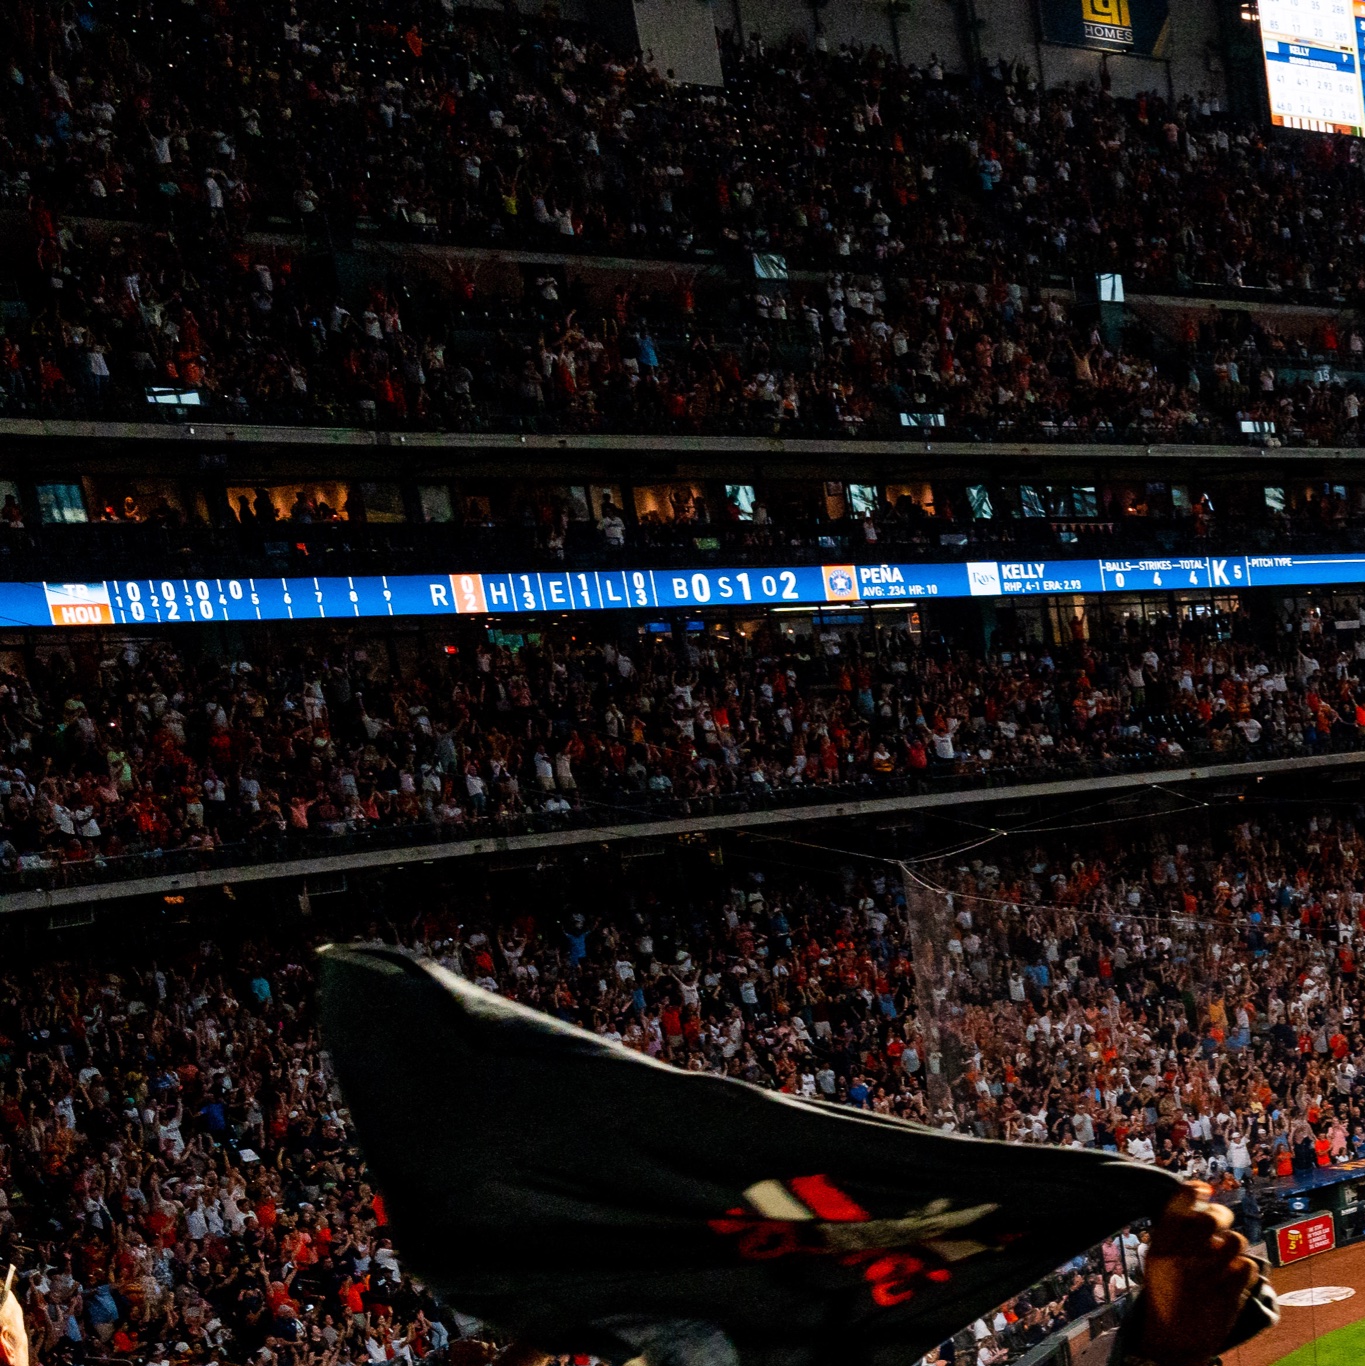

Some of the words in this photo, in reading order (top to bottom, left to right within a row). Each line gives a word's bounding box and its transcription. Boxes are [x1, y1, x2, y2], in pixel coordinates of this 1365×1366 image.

[1085, 25, 1134, 42] HOMES
[1105, 561, 1131, 572] BALLS
[1139, 560, 1172, 571] STRIKES
[1179, 559, 1204, 570] TOTAL
[1251, 558, 1272, 567] PITCH
[1273, 557, 1292, 567] TYPE
[860, 564, 904, 584] PEÑA
[1002, 563, 1045, 580] KELLY
[862, 586, 885, 597] AVG:
[886, 585, 906, 597] .234
[908, 585, 926, 595] HR:
[1026, 580, 1041, 592] 4-1
[1043, 580, 1063, 591] ERA:
[1064, 579, 1082, 591] 2.93
[62, 606, 101, 623] HOU
